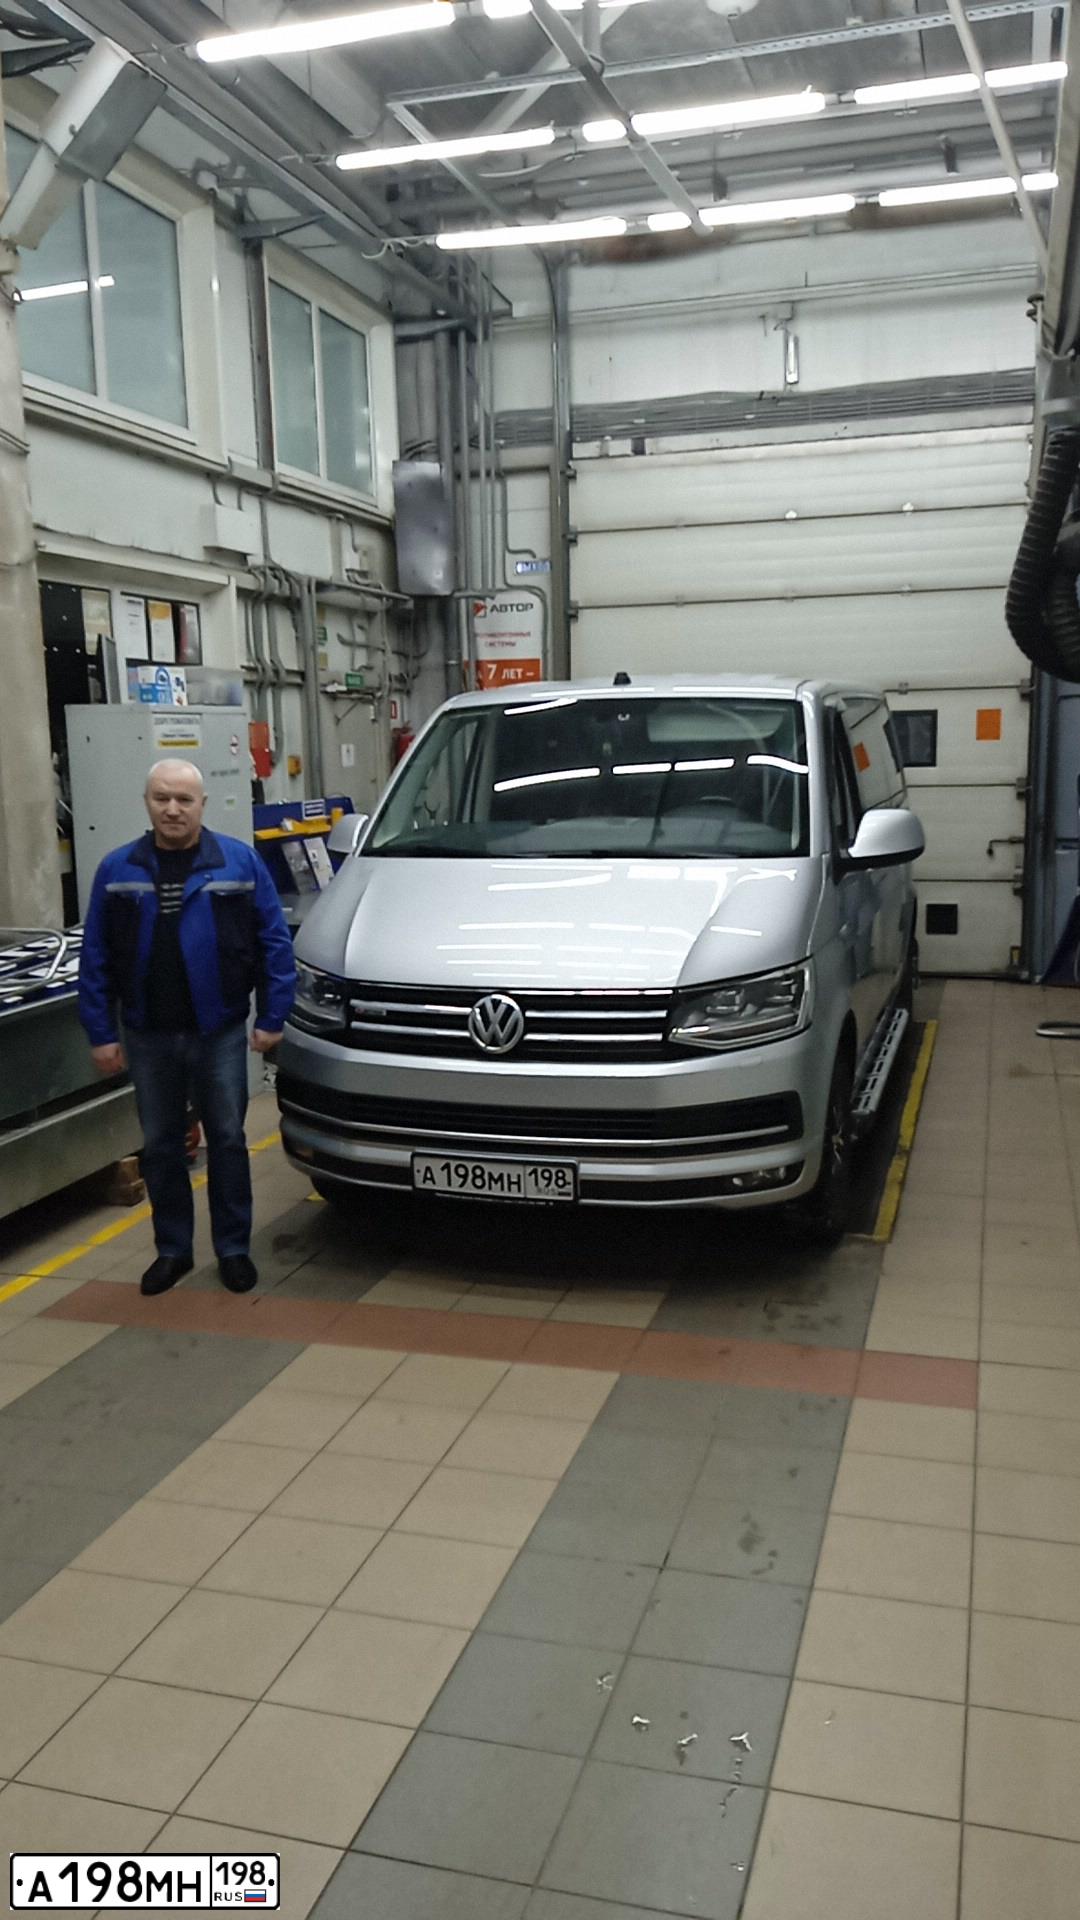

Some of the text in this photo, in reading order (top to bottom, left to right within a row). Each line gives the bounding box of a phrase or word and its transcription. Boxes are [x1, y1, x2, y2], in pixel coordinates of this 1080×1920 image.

[490, 603, 534, 613] АВТОР
[487, 664, 497, 680] 7
[501, 668, 523, 679] ЛЕТ
[422, 1162, 566, 1193] А198МН 198
